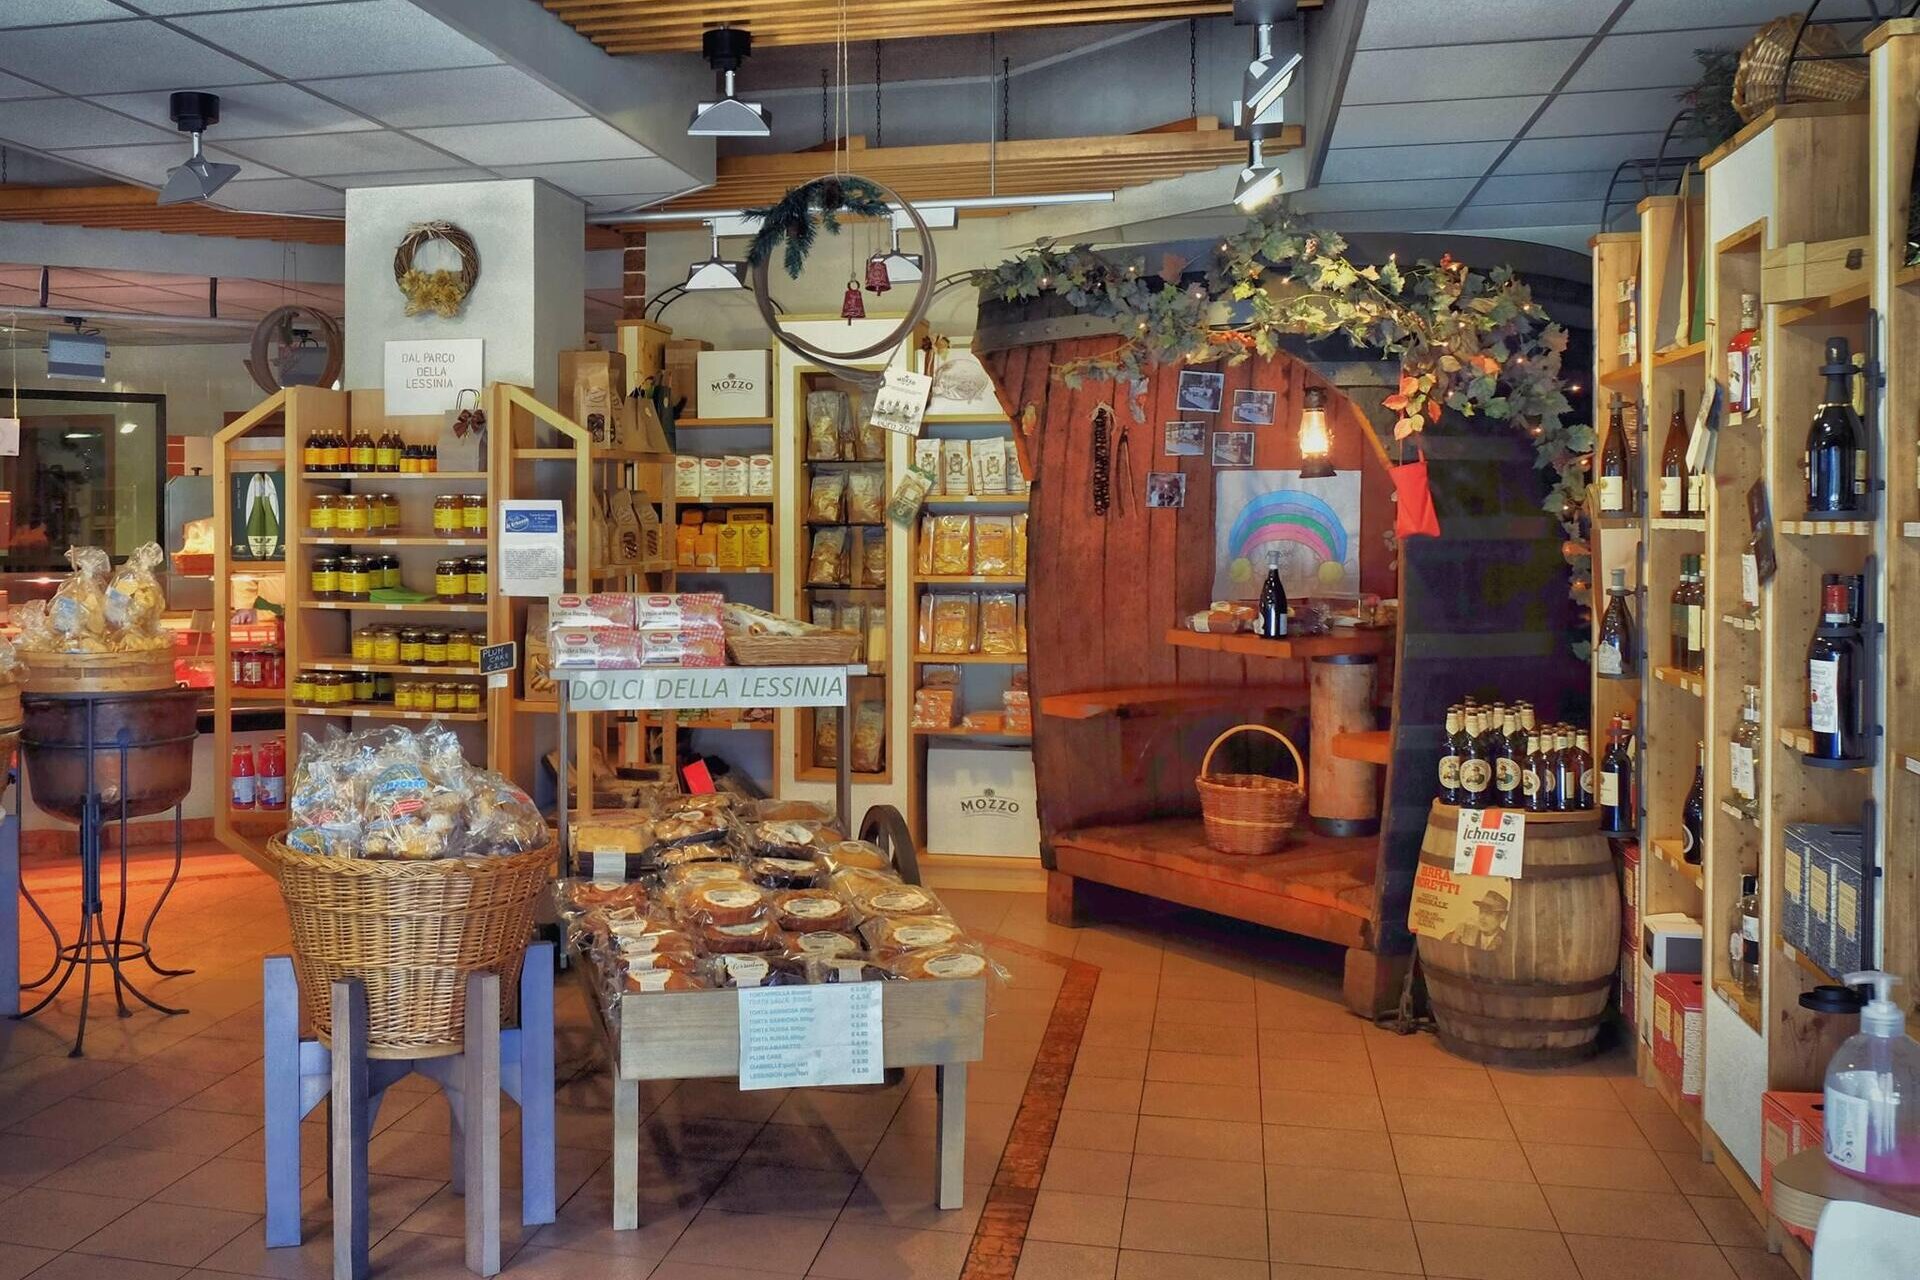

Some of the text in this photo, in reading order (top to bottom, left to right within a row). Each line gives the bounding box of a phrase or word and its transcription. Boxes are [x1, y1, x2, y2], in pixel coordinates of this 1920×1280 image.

[401, 352, 456, 364] DAL PARCO
[416, 366, 447, 377] DELLA
[405, 377, 454, 389] LESSINIA
[711, 380, 754, 392] MOZZO
[482, 646, 505, 658] PLUM
[571, 675, 843, 701] DOLCI DELLA LESSINIA
[960, 799, 1018, 812] MOZZO
